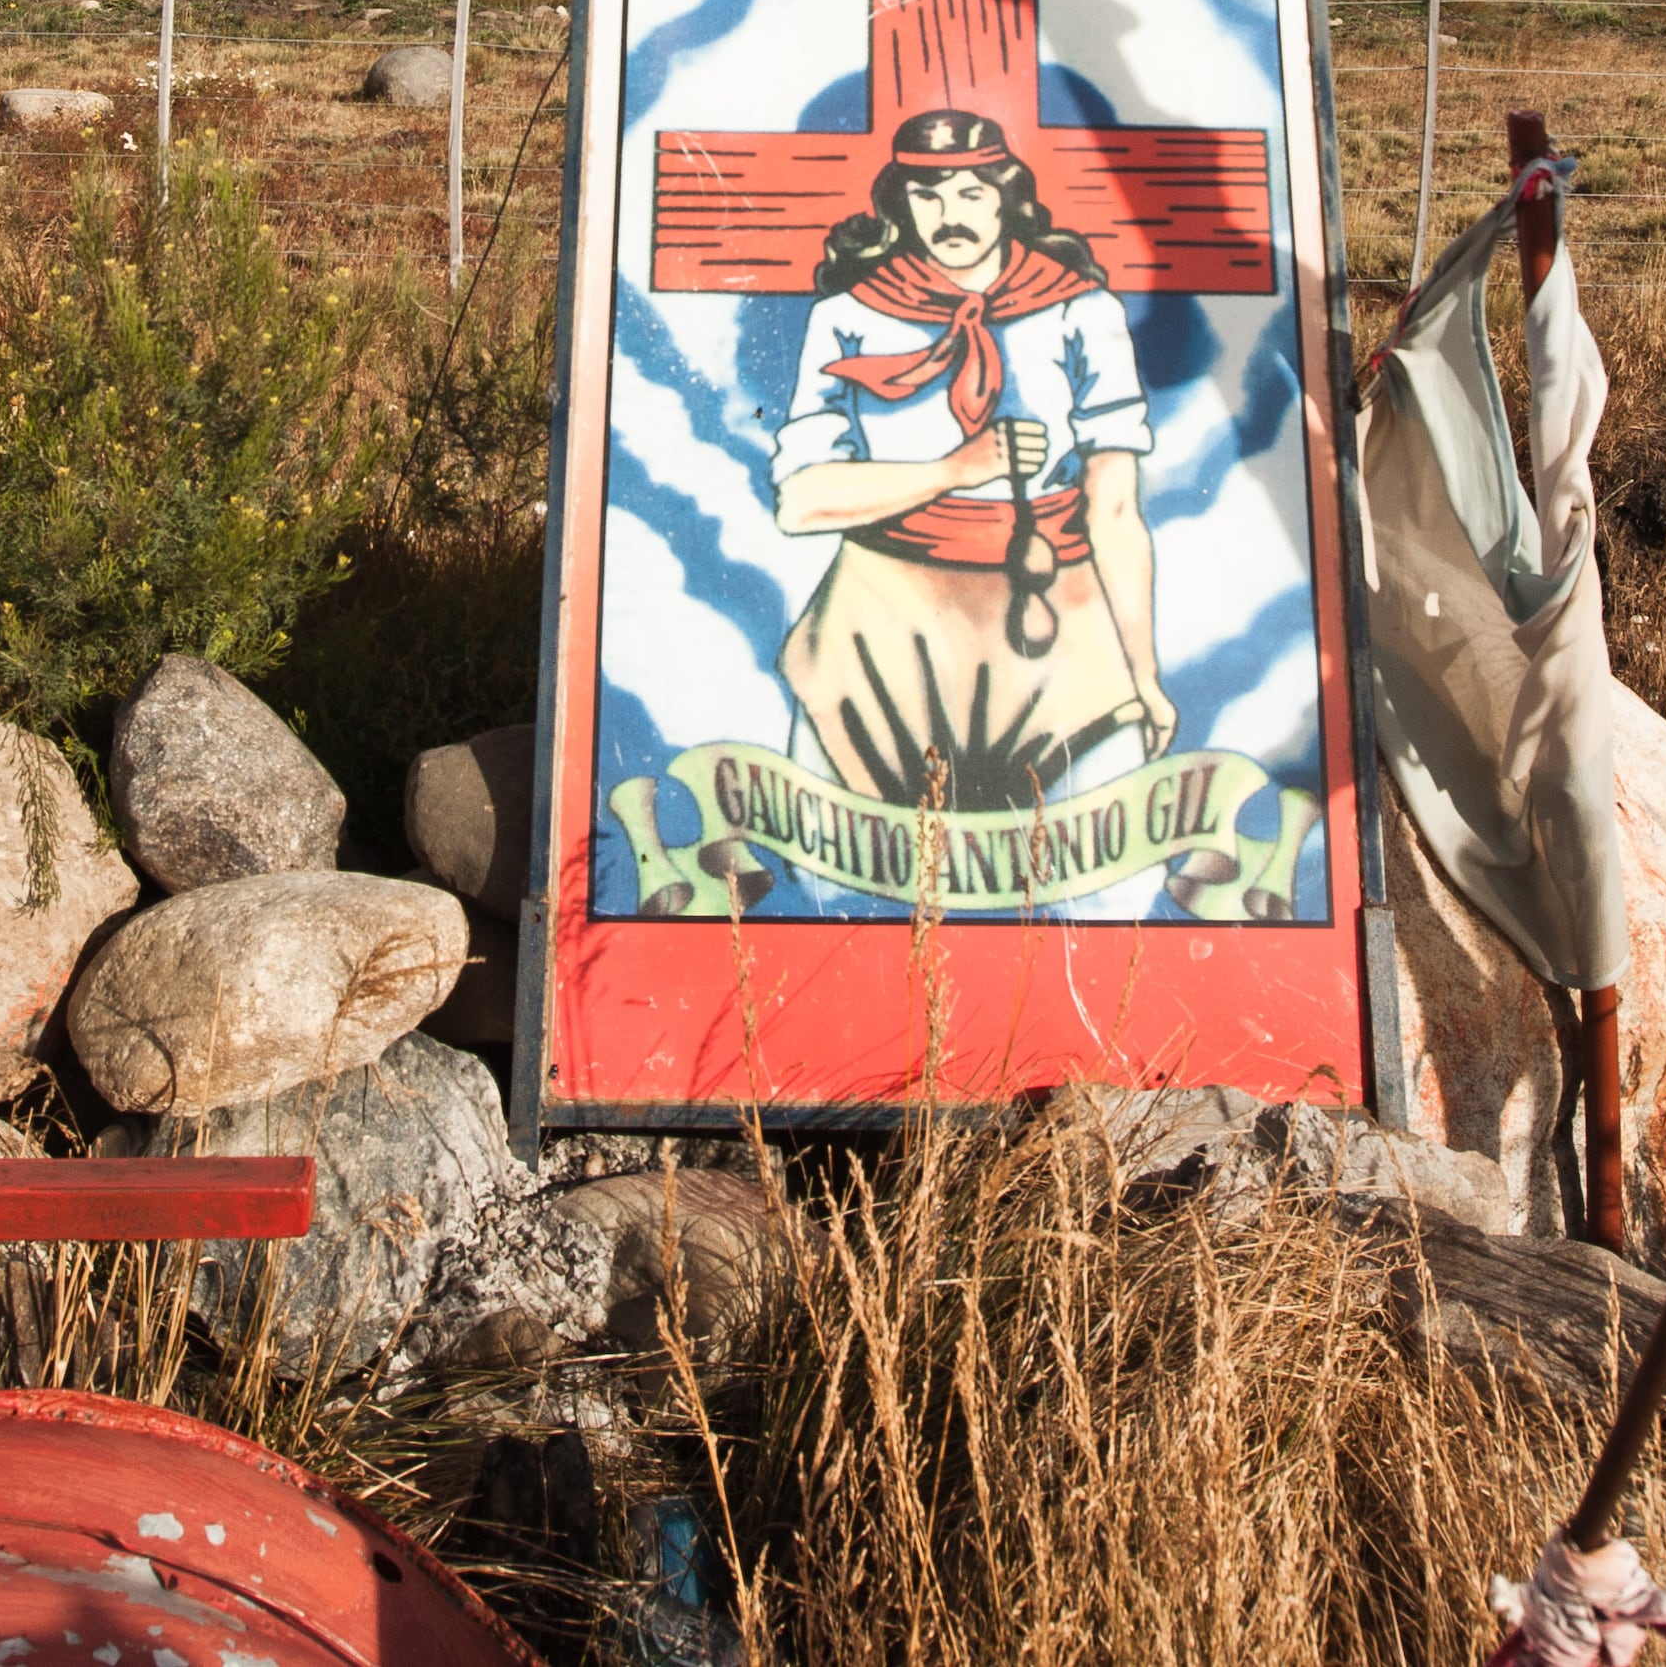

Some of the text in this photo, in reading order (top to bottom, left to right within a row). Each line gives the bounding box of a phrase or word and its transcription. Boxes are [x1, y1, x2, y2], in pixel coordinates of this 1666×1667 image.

[715, 757, 1220, 894] GAUCHITO ANTONIO GIL
